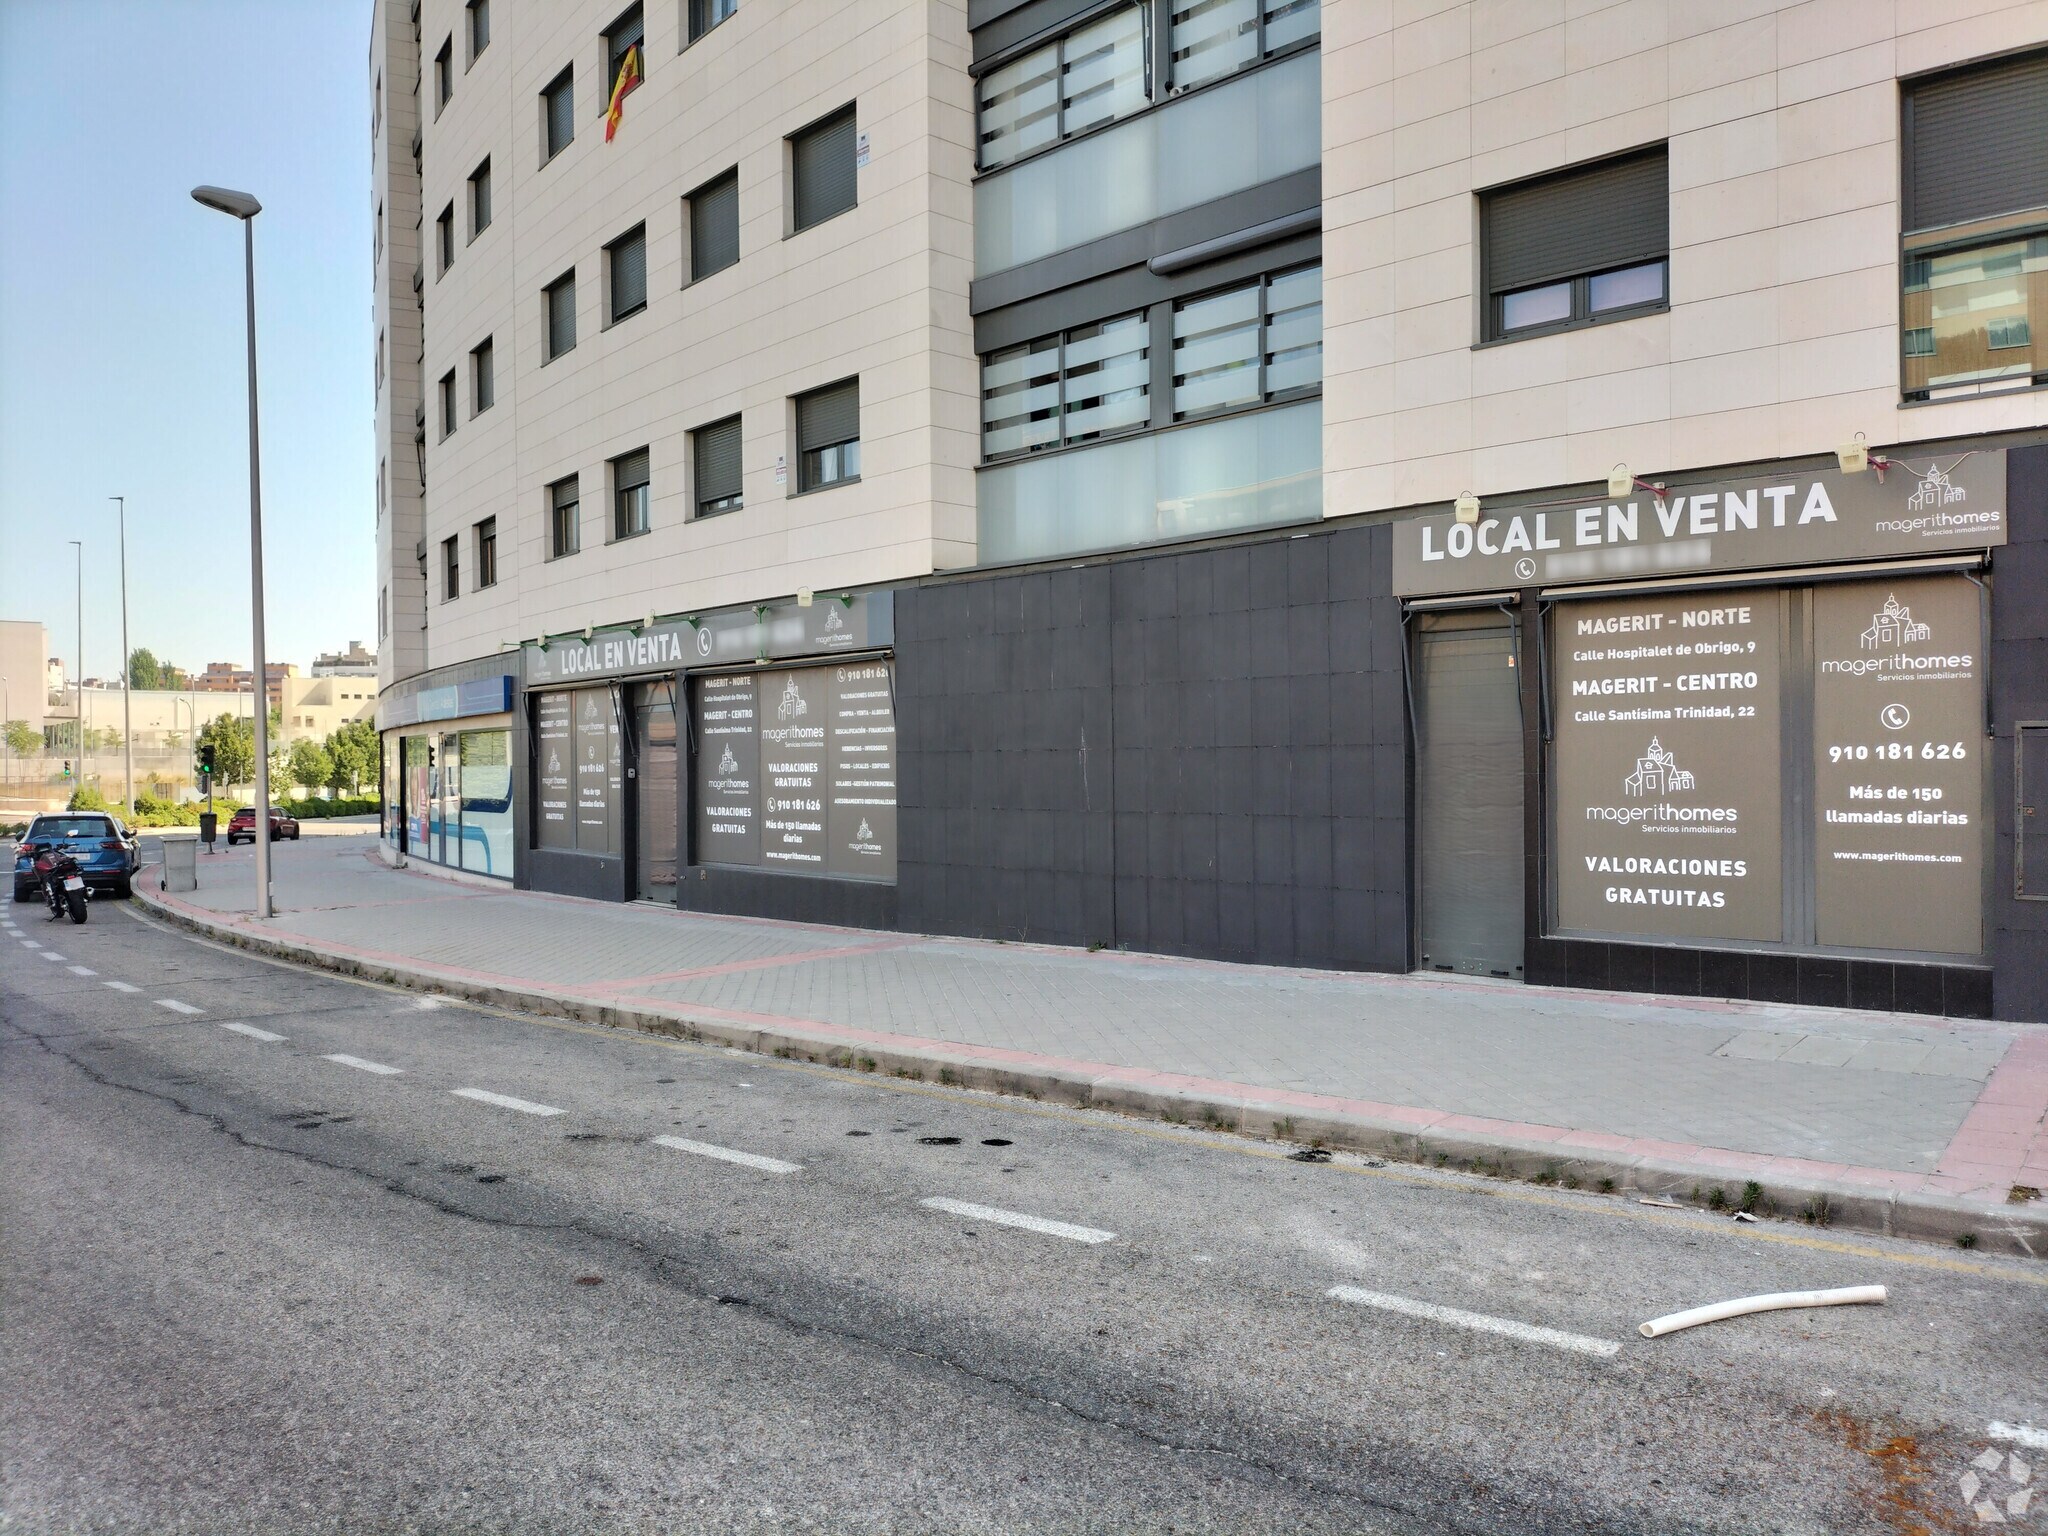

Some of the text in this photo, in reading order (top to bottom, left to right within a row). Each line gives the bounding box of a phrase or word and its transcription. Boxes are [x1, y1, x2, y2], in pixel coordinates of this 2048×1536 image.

[1422, 512, 1561, 562] LOCAL
[1575, 502, 1639, 547] EN
[1654, 482, 1838, 537] VENTA
[1875, 511, 2000, 533] magerithomes
[1921, 524, 2000, 537] Servicios inmobiliarios
[1577, 613, 1664, 636] MAGERIT
[1682, 606, 1751, 628] NORTE
[561, 645, 602, 675] LOCAL
[605, 640, 624, 669] EN
[627, 632, 682, 666] VENTA
[1573, 640, 1756, 662] Calle Hospitalet de Obrigo, 9
[1822, 653, 1973, 676] magerithomes
[705, 678, 728, 689] MAGERIT
[732, 676, 751, 687] NORTE
[847, 670, 861, 682] 910
[861, 668, 875, 679] 181
[1877, 671, 1972, 682] Servicios inmobiliarios
[1572, 676, 1658, 696] MAGERIT
[1676, 671, 1758, 692] CENTRO
[704, 710, 728, 720] MAGERIT
[731, 709, 753, 719] CENTRO
[1574, 705, 1755, 722] Calle Santísima Trinidad, 22
[762, 725, 824, 742] magerithomes
[1828, 741, 1966, 763] 910 181 626
[768, 762, 819, 773] VALORACIONES
[708, 778, 750, 790] magerithomes
[774, 777, 812, 787] GRATUITAS
[1849, 784, 1943, 802] Más de 150
[706, 806, 752, 817] VALORACIONES
[777, 798, 821, 811] 910 181 626
[1586, 803, 1738, 825] magerithomes
[1825, 809, 1968, 825] llamadas diarias
[712, 823, 746, 834] GRATUITAS
[765, 819, 777, 829] Más
[777, 820, 785, 829] de
[795, 820, 822, 831] llamadas
[1641, 824, 1737, 834] Servicios inmobiliarios
[783, 833, 803, 843] diarias
[1833, 851, 1962, 863] www.magerithomes.com
[1584, 856, 1747, 877] VALORACIONES
[1605, 887, 1726, 908] GRATUITAS
